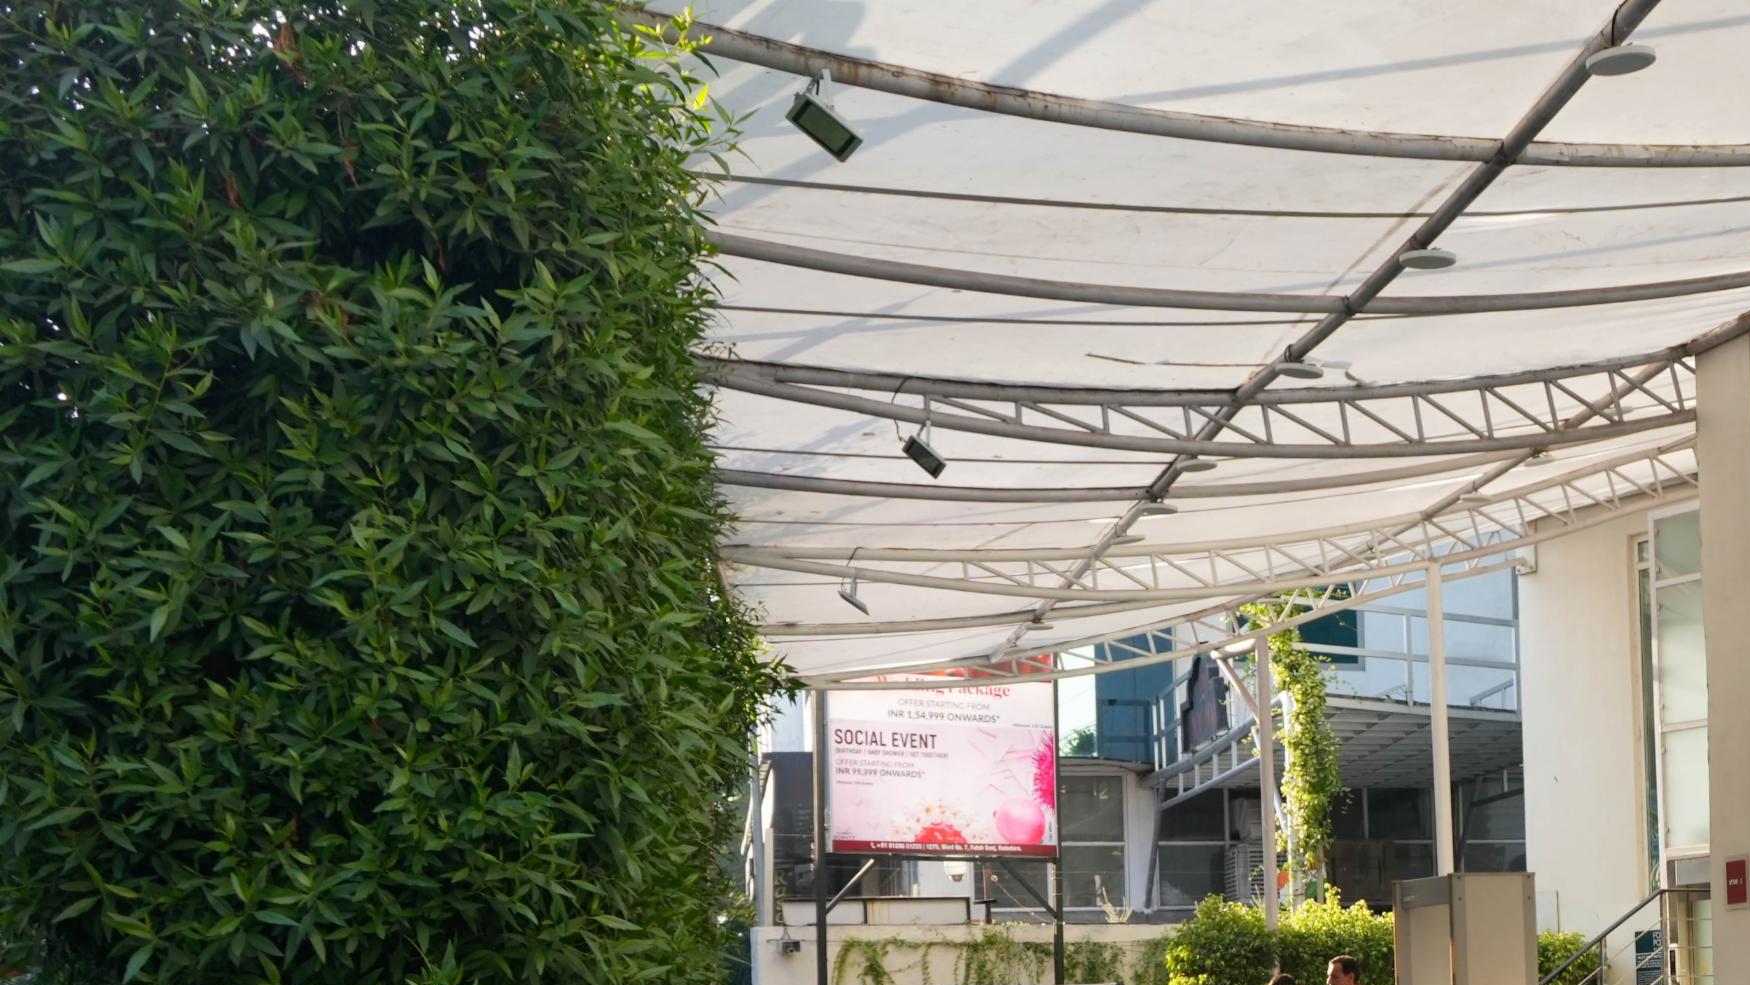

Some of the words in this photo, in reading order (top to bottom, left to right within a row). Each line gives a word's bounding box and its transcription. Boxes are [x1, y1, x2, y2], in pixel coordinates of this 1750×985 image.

[898, 698, 924, 707] OFFER
[926, 699, 964, 709] STARTING
[967, 702, 990, 710] FROM
[888, 709, 904, 718] INR
[834, 728, 887, 747] SOCIAL
[891, 732, 937, 749] EVENT
[835, 758, 857, 766] OFFER
[859, 759, 892, 768] STARTING
[894, 761, 914, 769] FROM
[835, 767, 850, 775] INR
